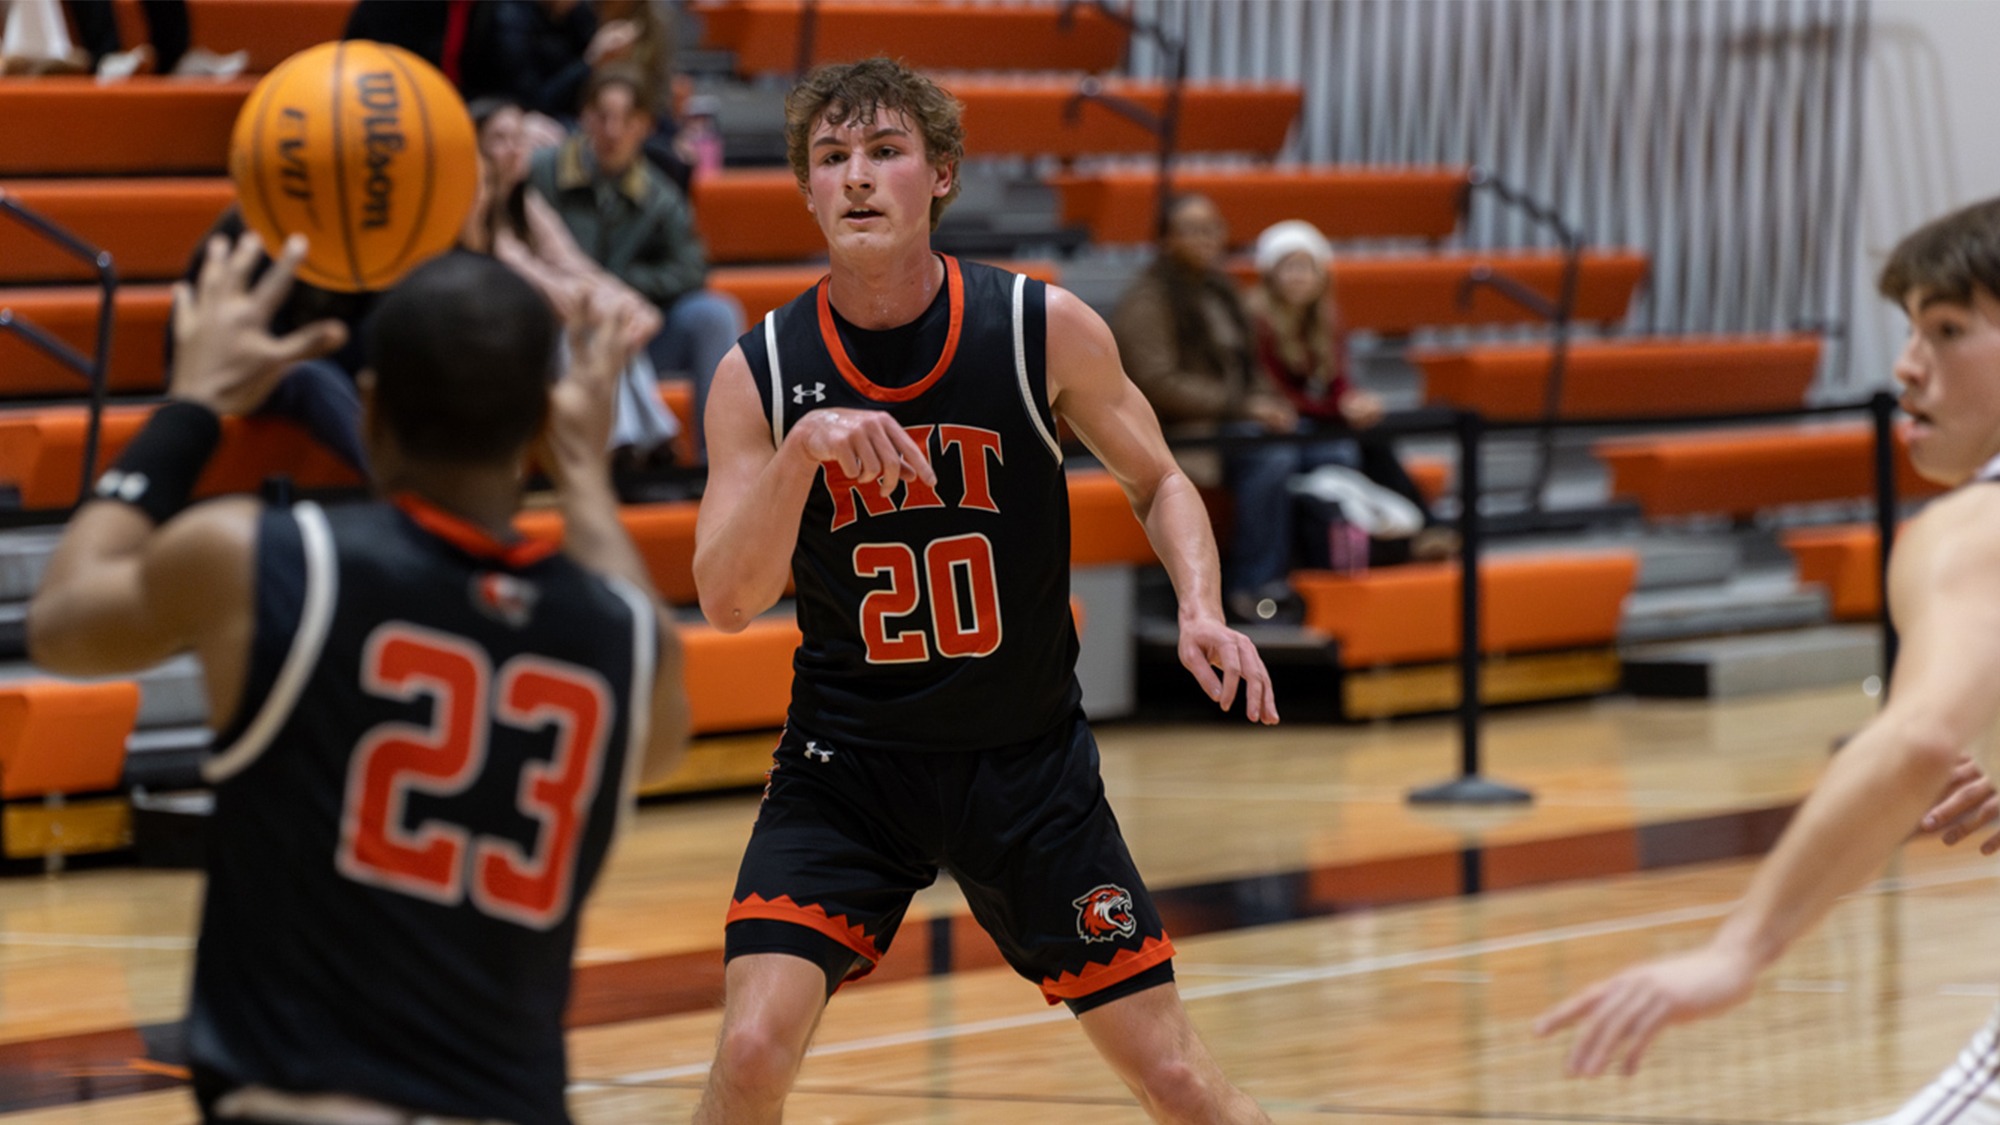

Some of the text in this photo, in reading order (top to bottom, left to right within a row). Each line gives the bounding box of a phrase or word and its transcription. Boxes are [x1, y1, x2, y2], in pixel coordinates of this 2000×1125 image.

[357, 72, 406, 230] Wilson
[853, 532, 1002, 664] 20
[336, 620, 615, 930] 23
